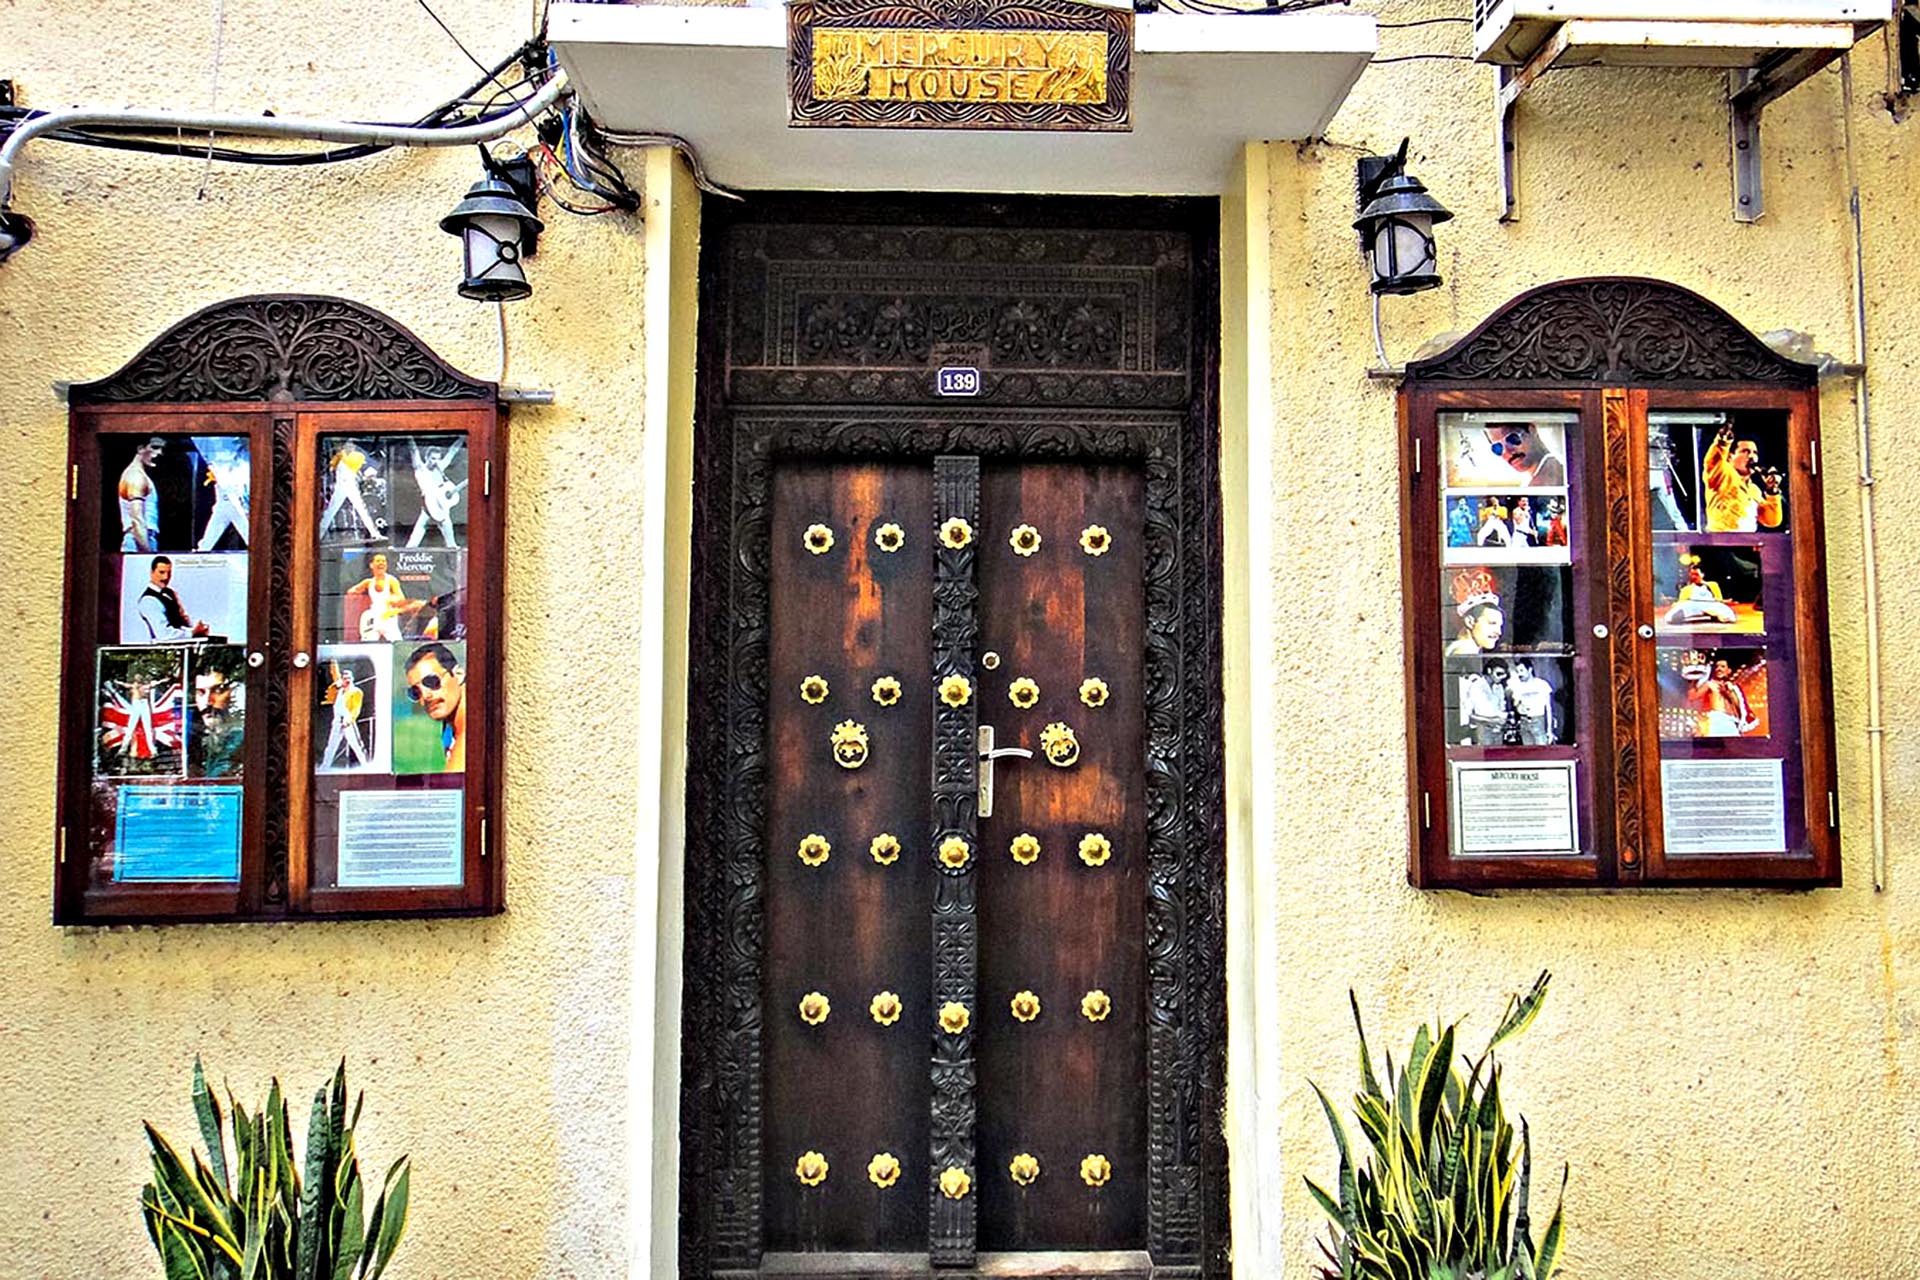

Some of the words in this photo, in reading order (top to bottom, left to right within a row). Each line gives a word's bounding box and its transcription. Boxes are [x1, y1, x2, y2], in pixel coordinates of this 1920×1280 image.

[857, 32, 1062, 68] MERCURY
[888, 69, 1031, 100] HOUSE
[943, 374, 975, 390] 139
[399, 552, 433, 563] Freddie
[396, 562, 436, 573] Mercury
